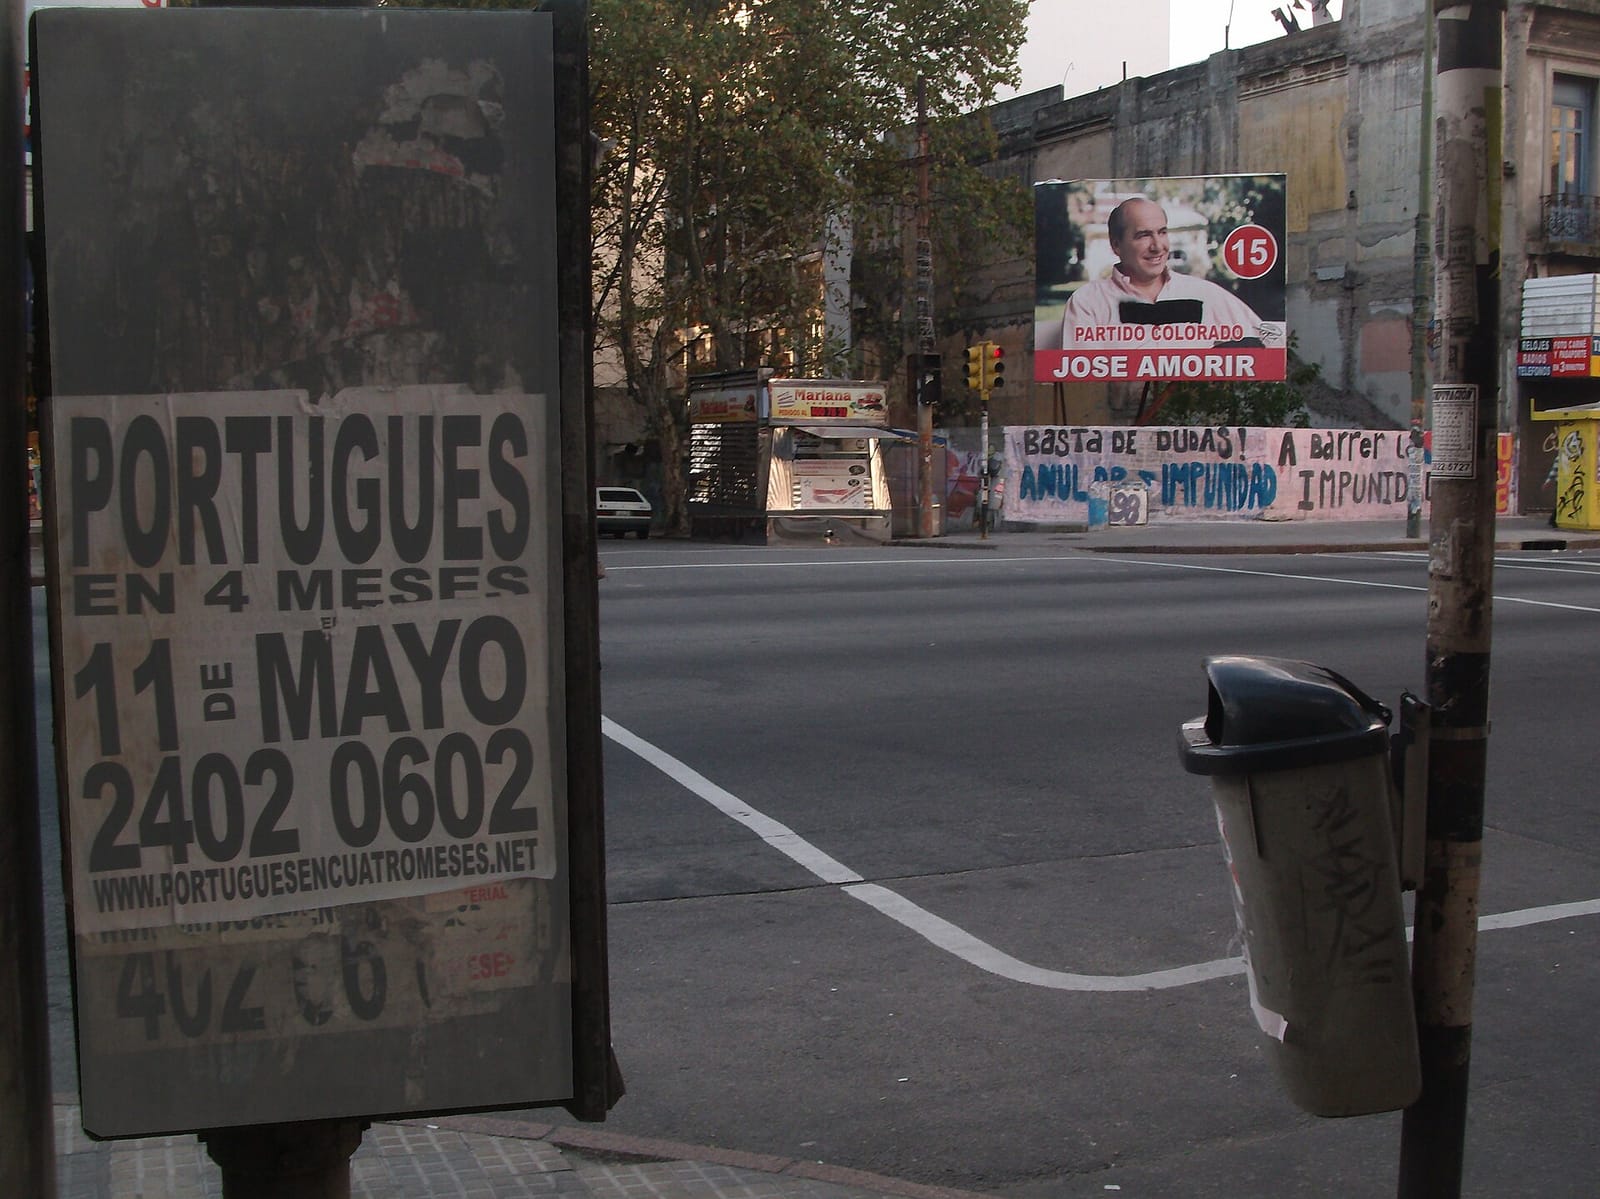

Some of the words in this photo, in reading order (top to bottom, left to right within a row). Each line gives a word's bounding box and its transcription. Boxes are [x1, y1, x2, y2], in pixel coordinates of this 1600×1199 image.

[1231, 238, 1268, 267] 15
[1075, 326, 1145, 342] PARTIDO
[1151, 324, 1244, 341] COLORADO
[1521, 340, 1550, 351] RELOJES
[1053, 355, 1128, 379] JOSE
[1136, 355, 1255, 378] AMORIR
[1559, 361, 1566, 373] 3
[795, 389, 851, 401] Mariana
[1112, 430, 1137, 455] DE
[1278, 431, 1297, 466] A
[71, 412, 530, 568] PORTUGUES
[1161, 462, 1278, 512] IMPUNIDAD
[74, 572, 175, 616] EN
[203, 570, 249, 613] 4
[75, 638, 179, 756] 11
[200, 662, 236, 722] DE
[256, 615, 527, 743] MAYO
[82, 748, 300, 873] 2402
[330, 728, 538, 848] 0602
[93, 838, 538, 913] WWW.PORTUGUESENCUATROMESES.NET
